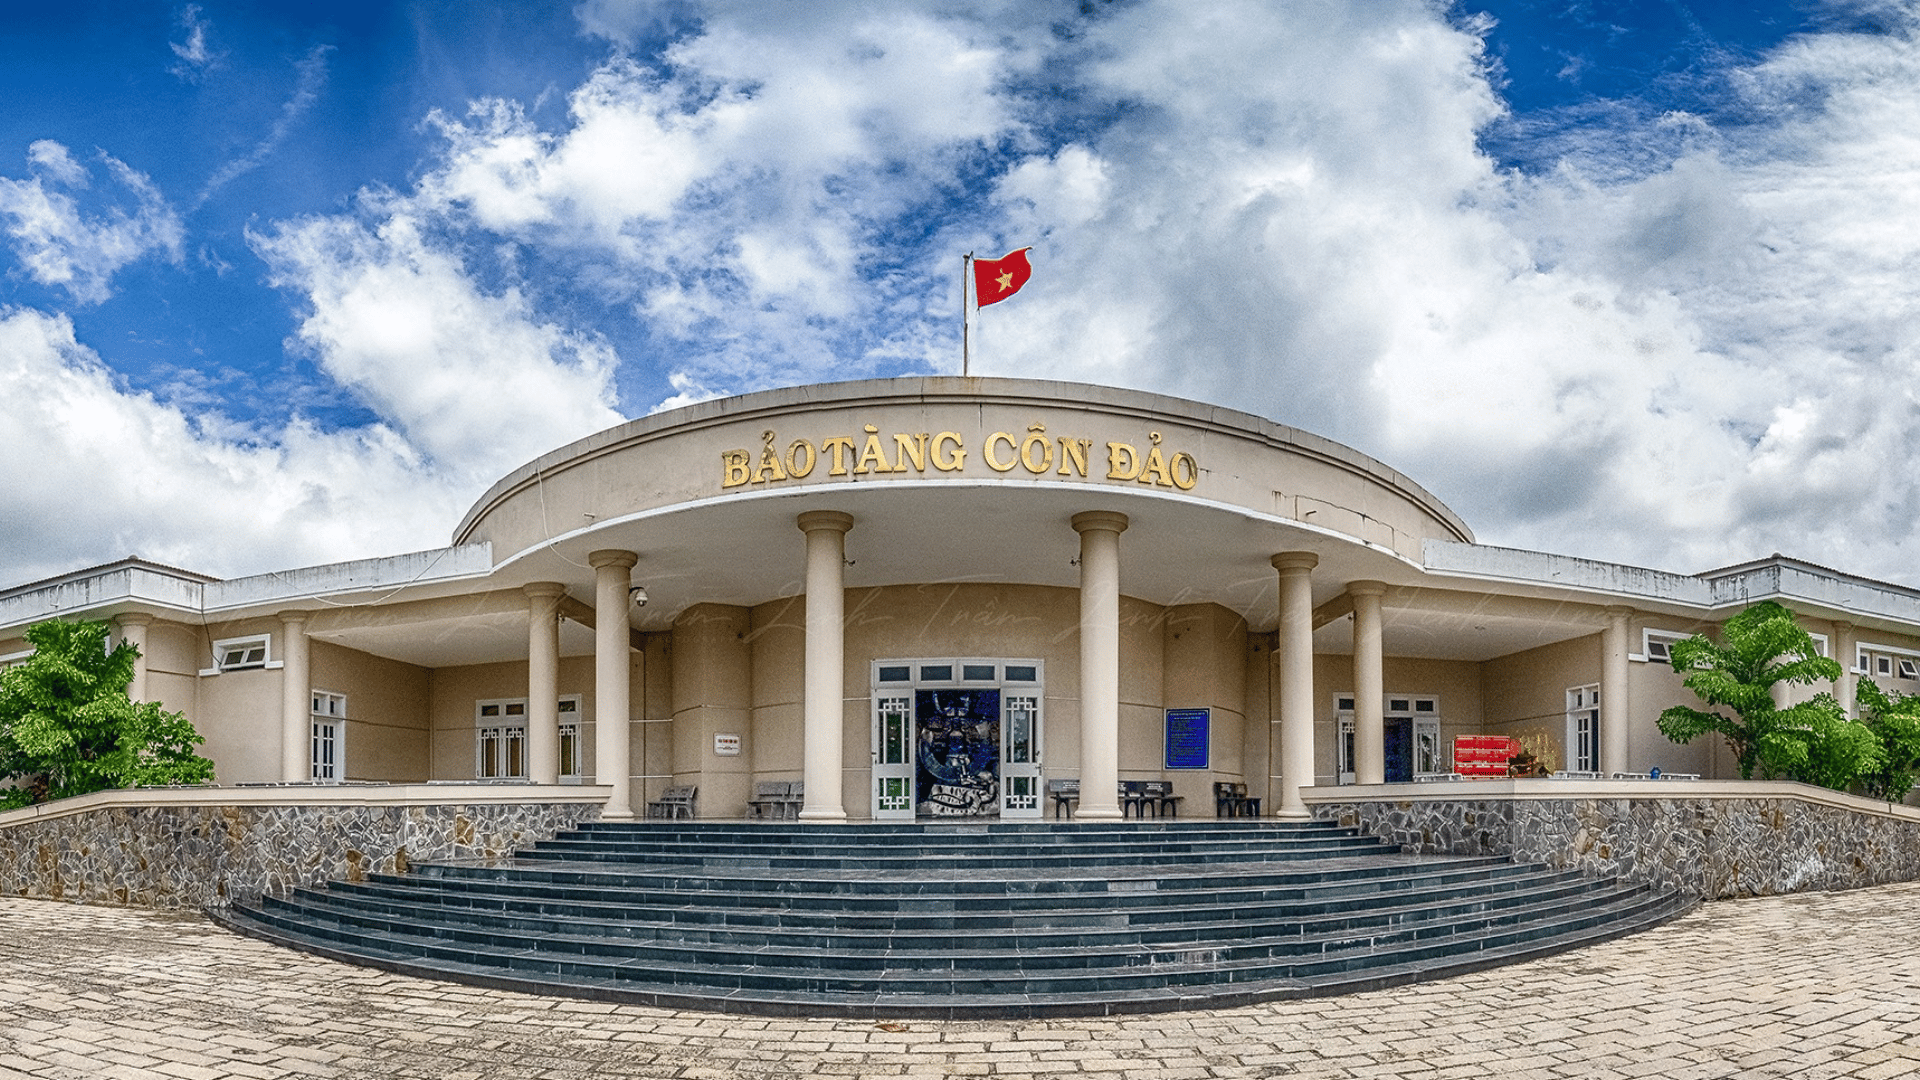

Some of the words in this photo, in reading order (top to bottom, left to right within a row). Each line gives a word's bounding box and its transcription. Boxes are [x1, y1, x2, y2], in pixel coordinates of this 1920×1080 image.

[722, 430, 817, 488] BẢO
[821, 424, 968, 476] TÀNG
[983, 421, 1093, 478] CÔN
[1106, 431, 1199, 490] ĐẢO
